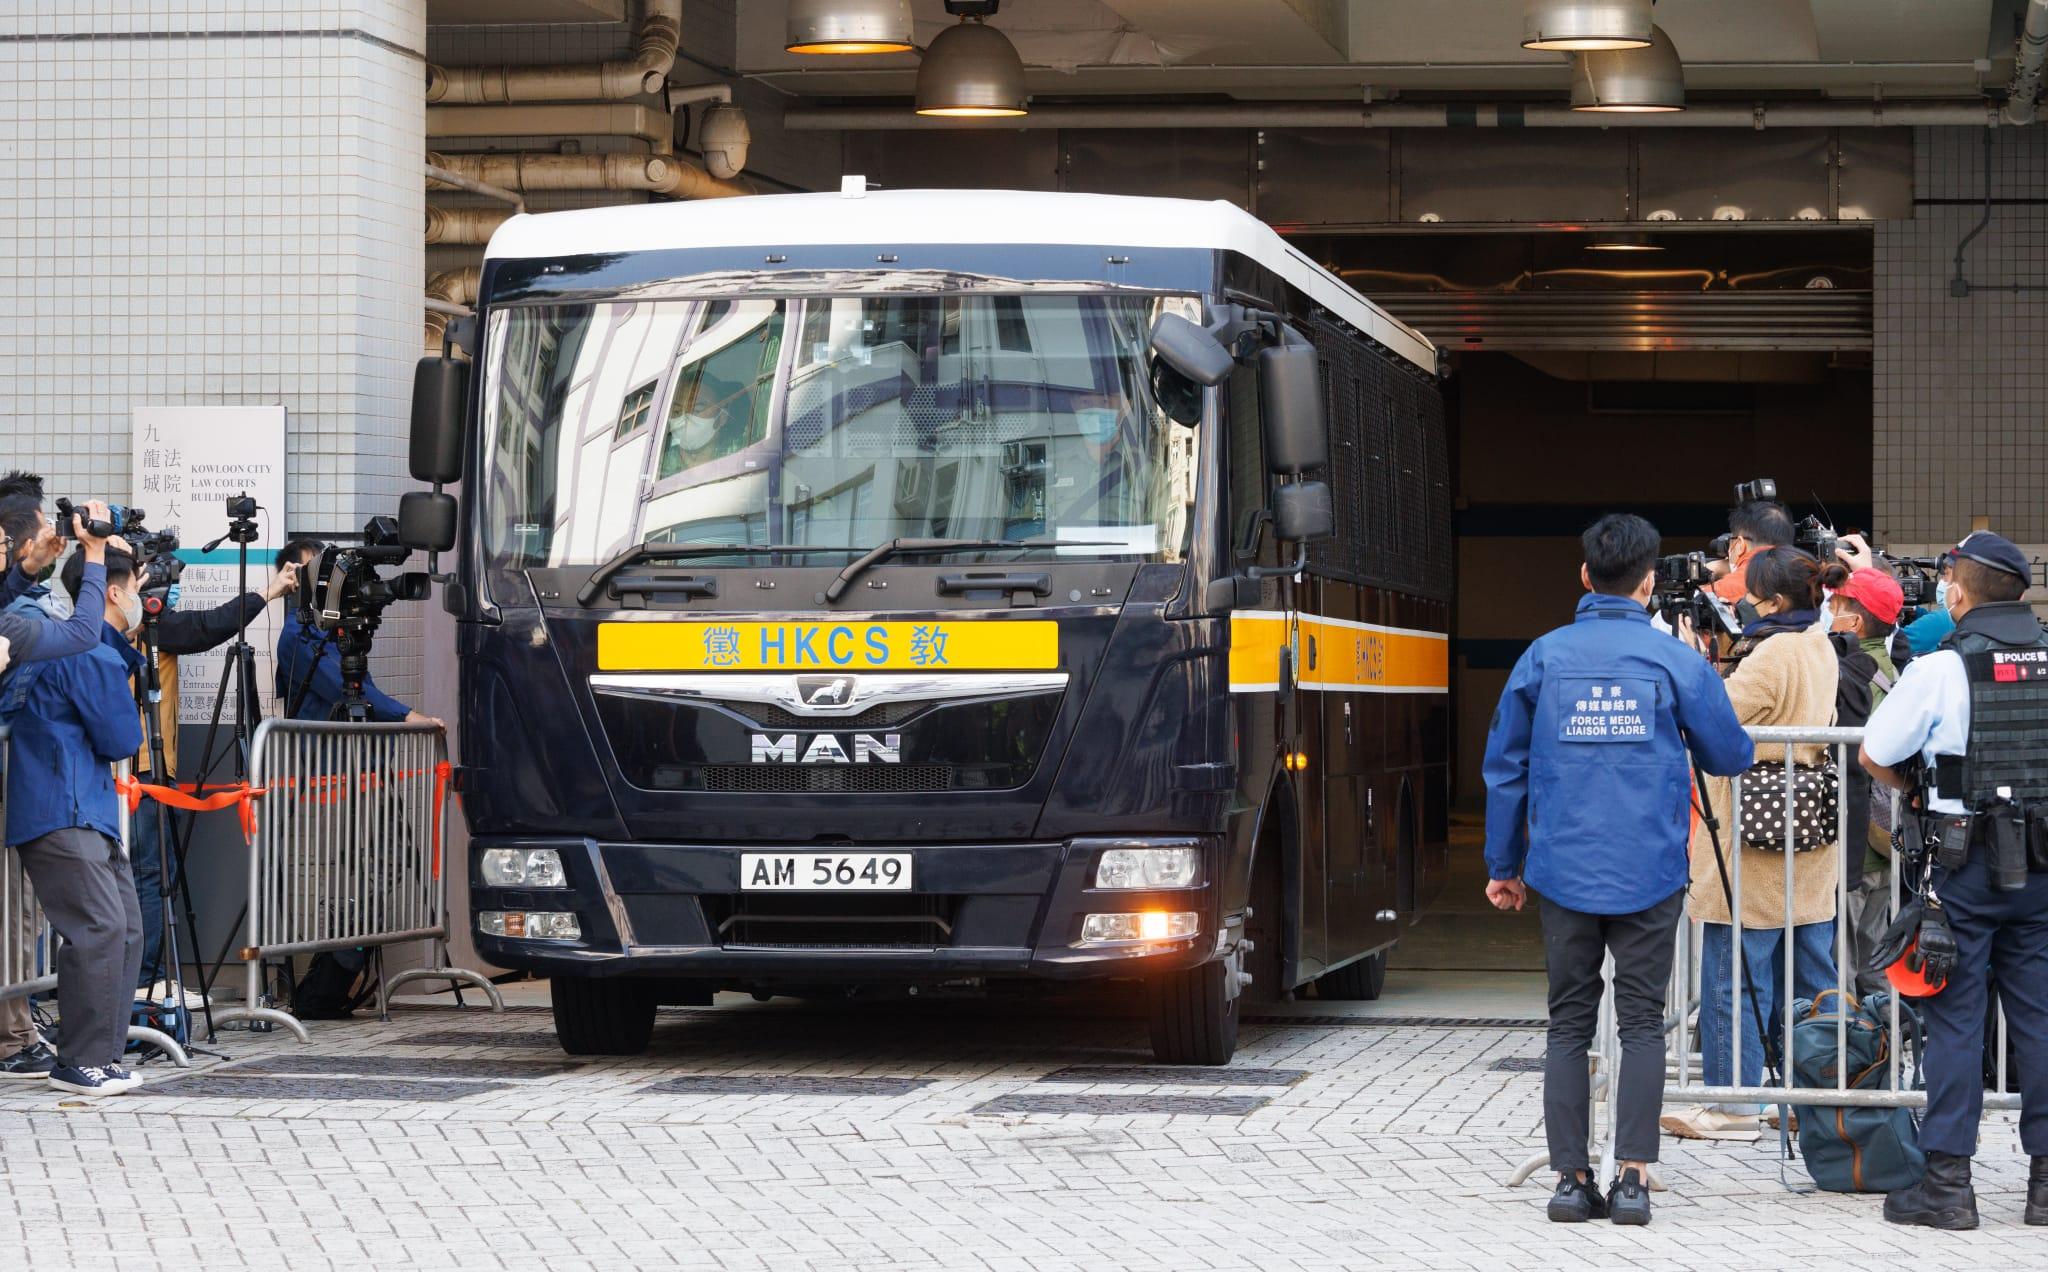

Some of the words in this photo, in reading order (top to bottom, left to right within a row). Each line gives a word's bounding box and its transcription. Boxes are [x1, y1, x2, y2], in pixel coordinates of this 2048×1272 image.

[143, 423, 160, 493] 九龍城
[191, 464, 246, 474] KOWLOON
[247, 464, 272, 474] CITY
[191, 478, 212, 488] LAW
[215, 478, 256, 488] COURTS
[190, 584, 219, 593] Vehicle
[222, 584, 260, 593] Entrnce
[761, 626, 890, 665] HKCS
[2004, 653, 2037, 662] POLICE
[183, 680, 219, 689] Entrance
[185, 712, 198, 720] and
[1571, 716, 1605, 725] FORCE
[1610, 715, 1641, 725] MEDIA
[1566, 726, 1607, 735] LIAISON
[1612, 725, 1646, 735] CADRE
[751, 734, 901, 763] MAN
[751, 858, 795, 887] AM
[812, 858, 902, 887] 5649
